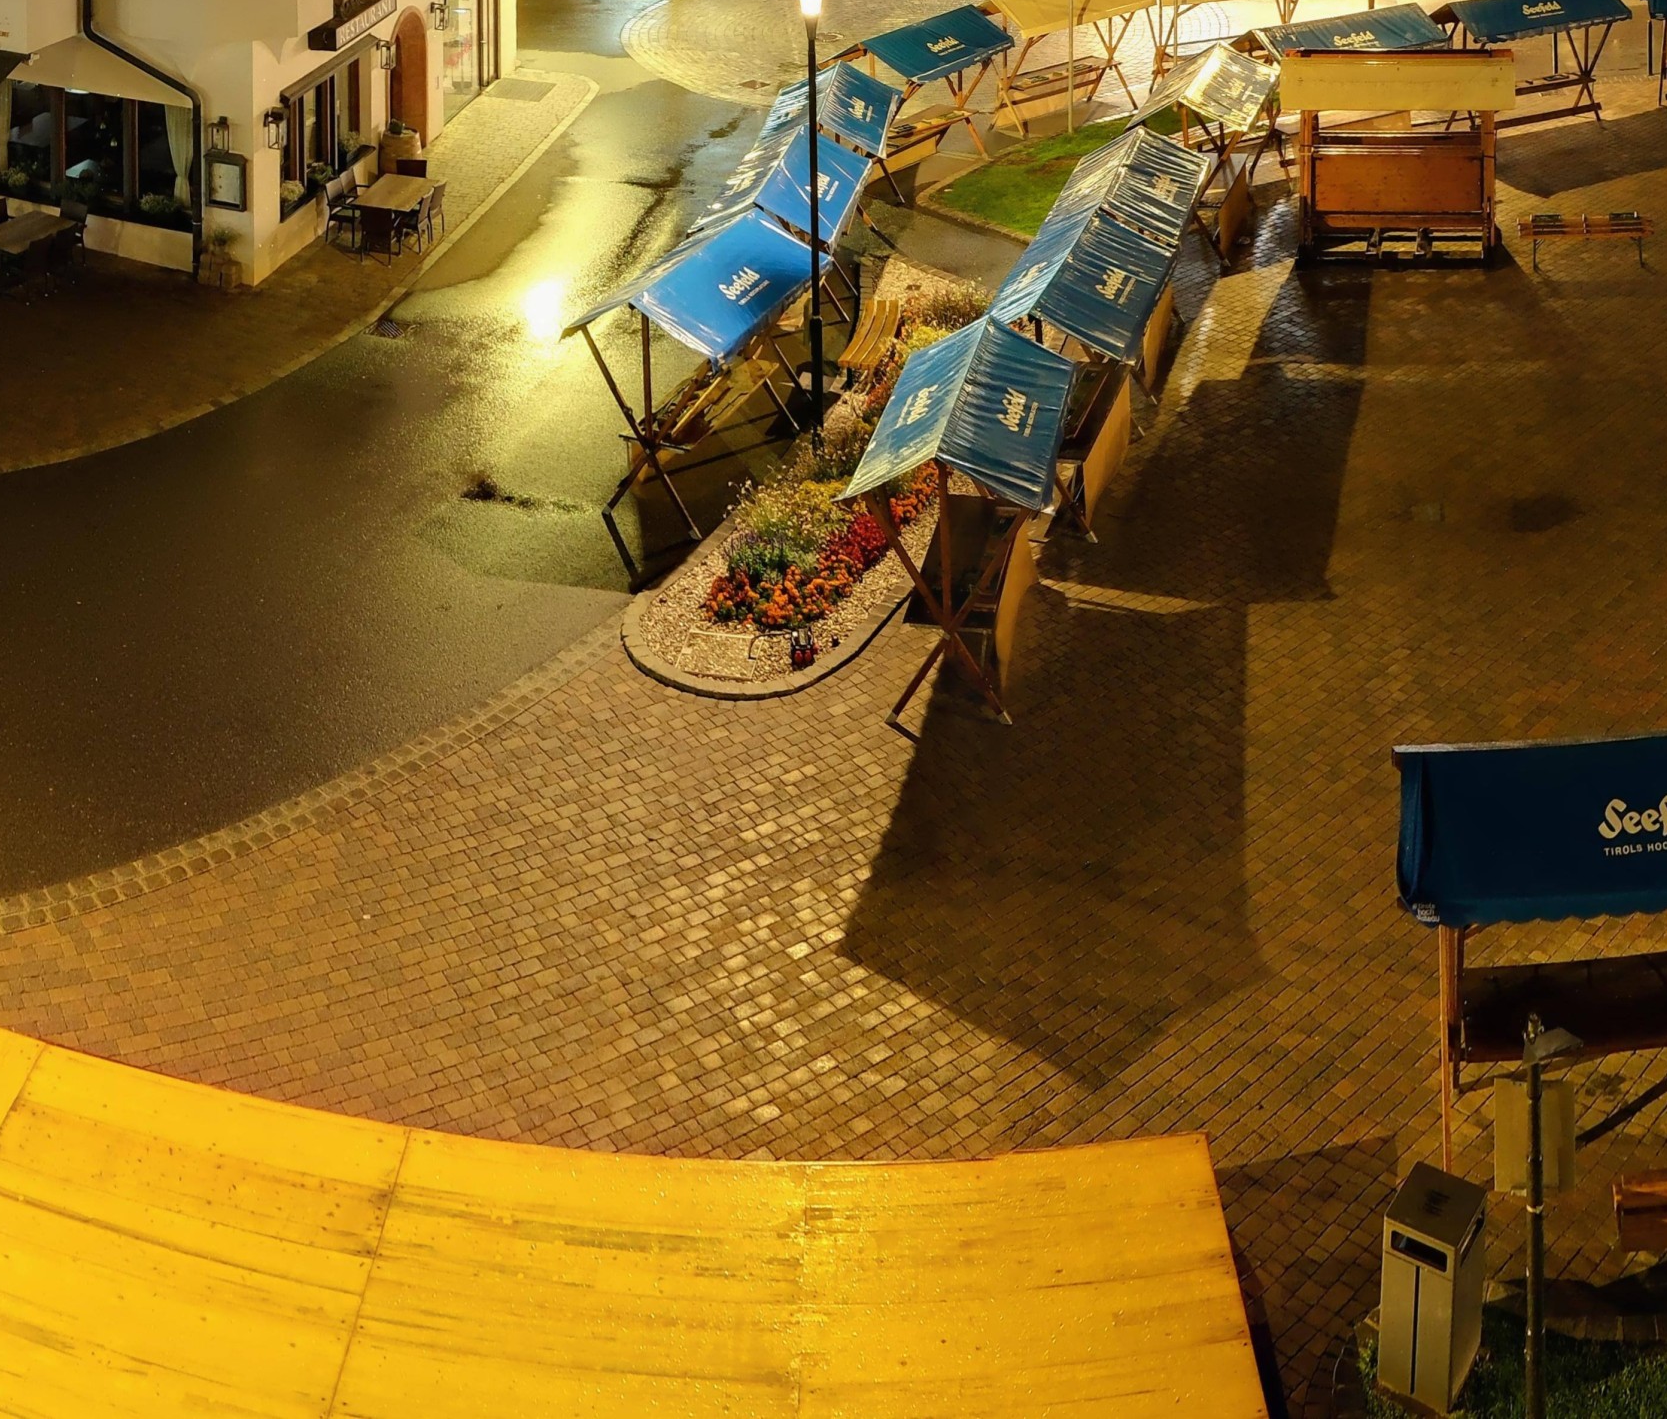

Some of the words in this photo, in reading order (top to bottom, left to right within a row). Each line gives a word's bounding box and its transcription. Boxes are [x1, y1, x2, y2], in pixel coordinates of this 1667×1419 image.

[1522, 0, 1562, 15] Seefeld
[1333, 30, 1376, 46] Seefeld
[718, 266, 761, 300] Seefeld
[1603, 844, 1644, 858] TIROLS
